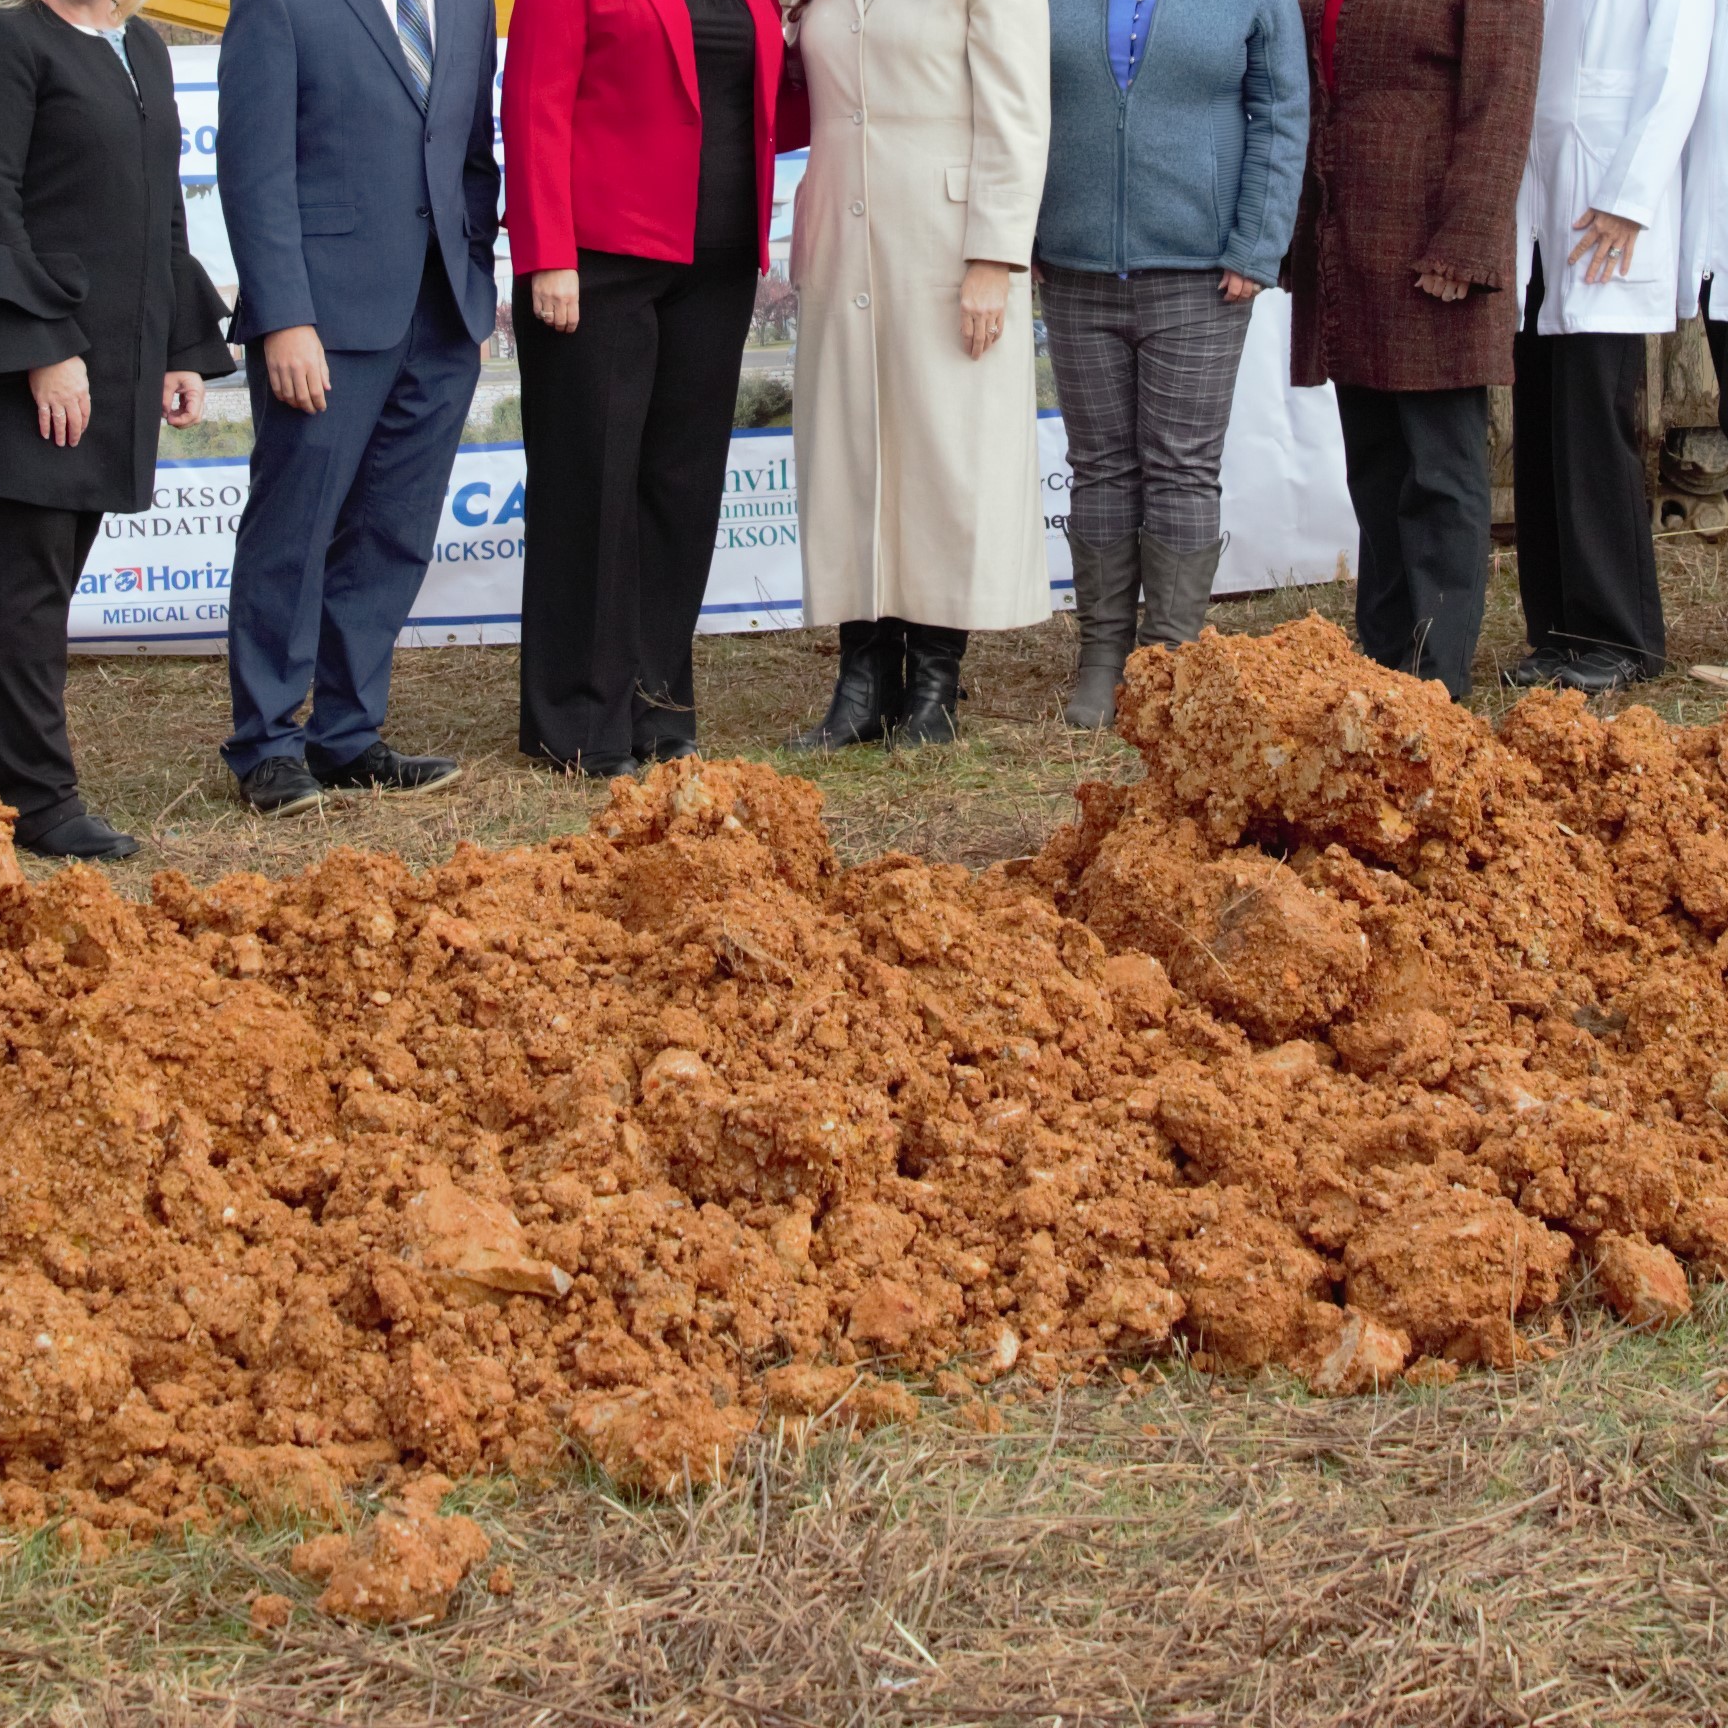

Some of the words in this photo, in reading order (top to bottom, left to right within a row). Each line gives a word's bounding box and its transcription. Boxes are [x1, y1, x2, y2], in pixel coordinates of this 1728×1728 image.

[152, 485, 252, 510] CKSO
[447, 479, 526, 528] CA
[73, 572, 113, 595] ar
[102, 605, 190, 625] MEDICAL
